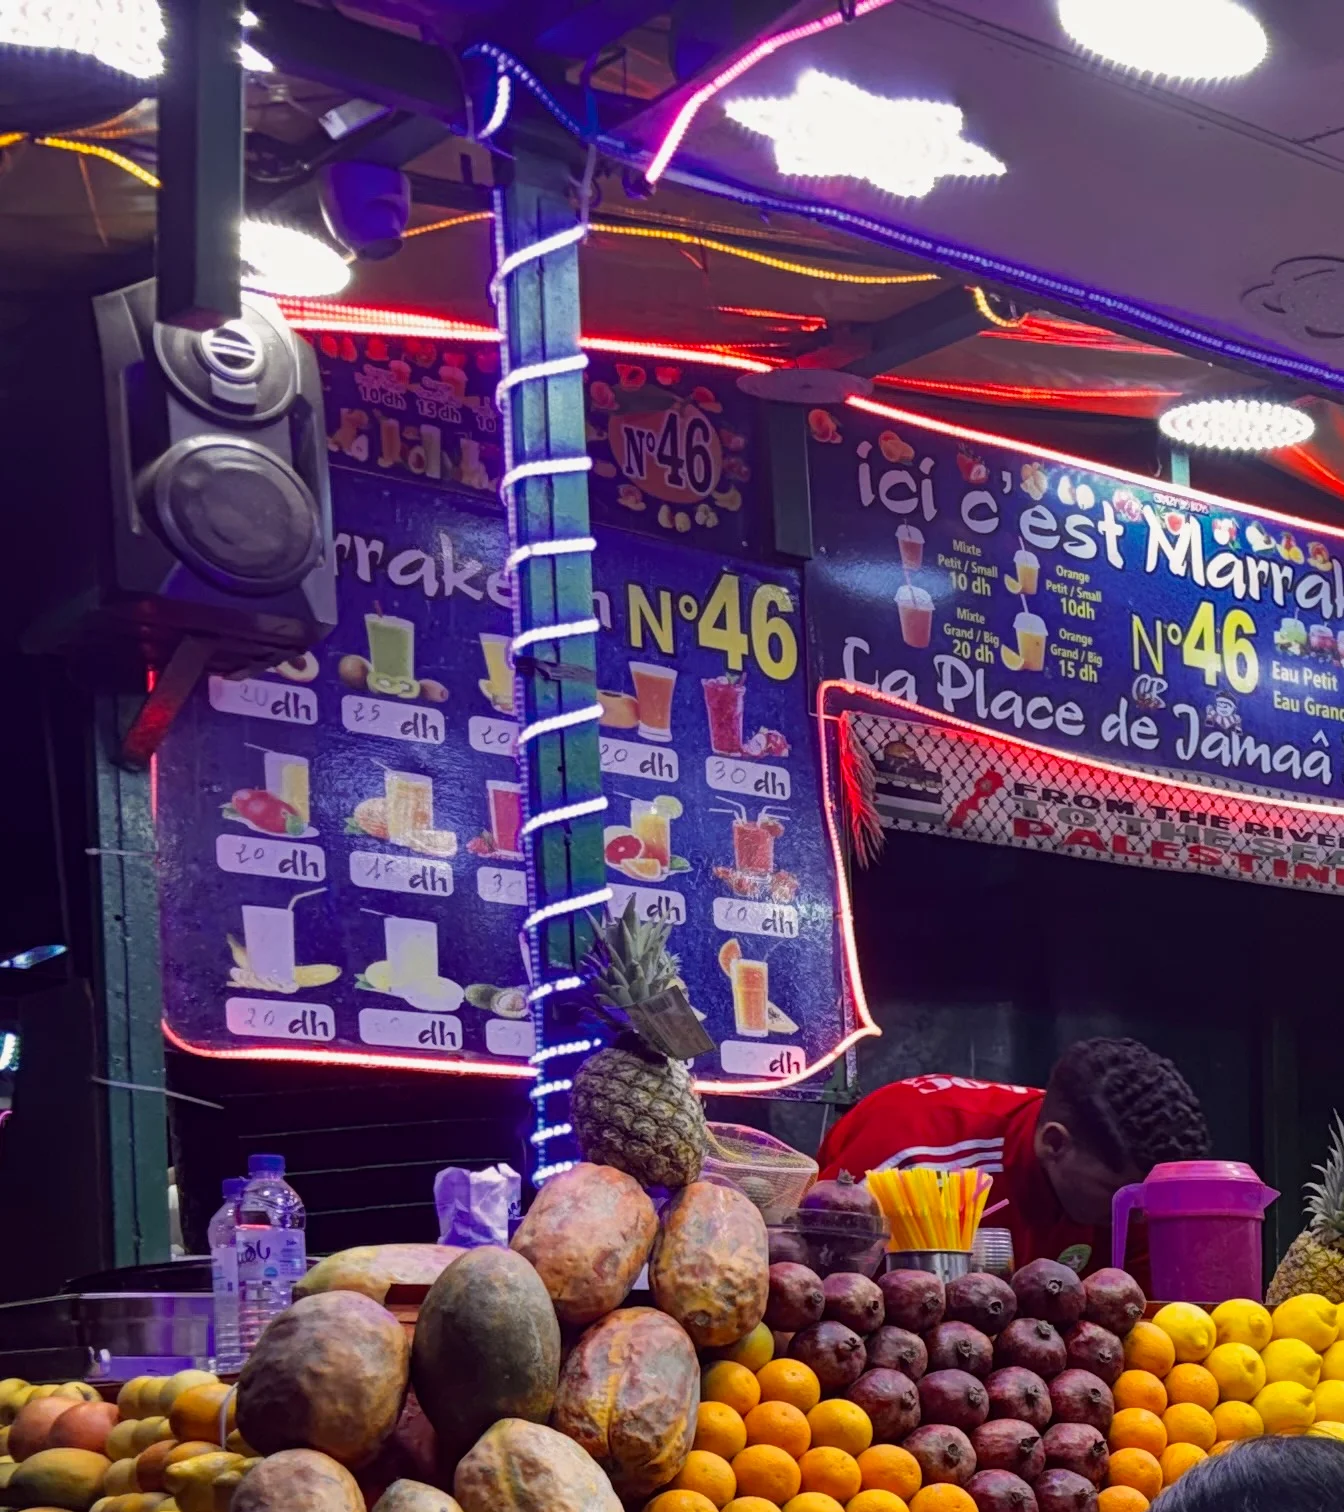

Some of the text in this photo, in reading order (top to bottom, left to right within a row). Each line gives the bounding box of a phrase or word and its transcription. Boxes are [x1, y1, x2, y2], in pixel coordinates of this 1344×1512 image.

[856, 440, 938, 522] ici
[952, 539, 982, 557] Mixte
[938, 554, 999, 579] Petit Small
[1055, 564, 1091, 584] Orange
[950, 572, 992, 597] 10 dh
[1046, 580, 1103, 603] Petit Small
[627, 571, 798, 682] N°46
[956, 607, 986, 625] Mixte
[943, 623, 1000, 648] Grand Big
[1058, 628, 1093, 648] Orange
[1131, 600, 1260, 694] N°46
[952, 640, 995, 665] 20 dh
[1050, 644, 1103, 668] Grand Big
[1059, 660, 1098, 684] 15 dh
[1272, 661, 1300, 685] Eau
[1302, 669, 1339, 692] Petit
[271, 692, 311, 720] dh
[841, 637, 918, 705] La
[934, 655, 1086, 737] Place
[1101, 697, 1160, 750] de
[1173, 704, 1332, 785] Jamaâ
[1273, 691, 1300, 713] Eau
[400, 712, 439, 742] dh
[639, 752, 674, 779] dh
[753, 771, 786, 797] dh
[1014, 783, 1134, 815] FROM
[1152, 806, 1231, 830] THE
[1013, 797, 1097, 828] TO
[1117, 815, 1235, 849] THE
[278, 850, 320, 877] dh
[408, 866, 448, 892] dh
[761, 910, 794, 935] dh
[288, 1010, 329, 1038] dh
[768, 1050, 801, 1074] dh
